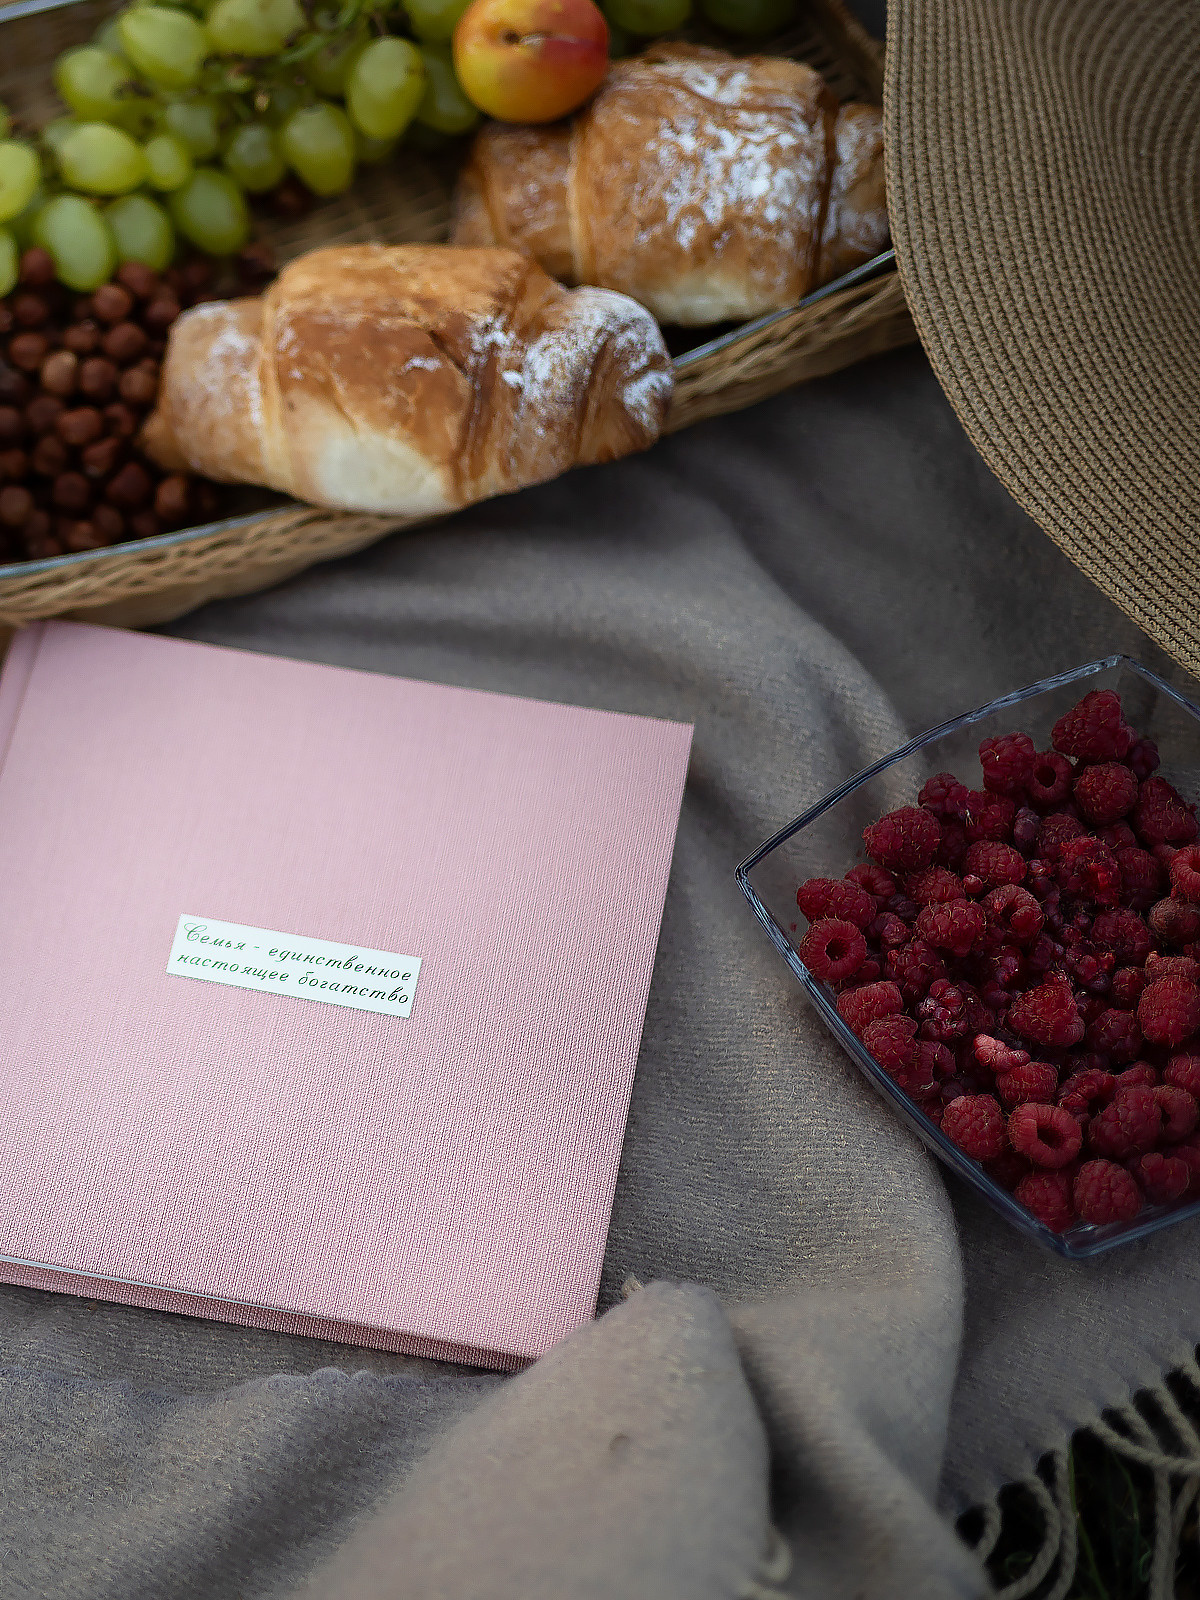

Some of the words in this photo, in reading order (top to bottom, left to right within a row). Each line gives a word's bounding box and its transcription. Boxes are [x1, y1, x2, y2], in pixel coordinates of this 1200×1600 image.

[177, 952, 290, 983] настоящее
[298, 971, 409, 1004] богатство
[183, 922, 247, 951] Семья
[268, 947, 412, 981] единственное
